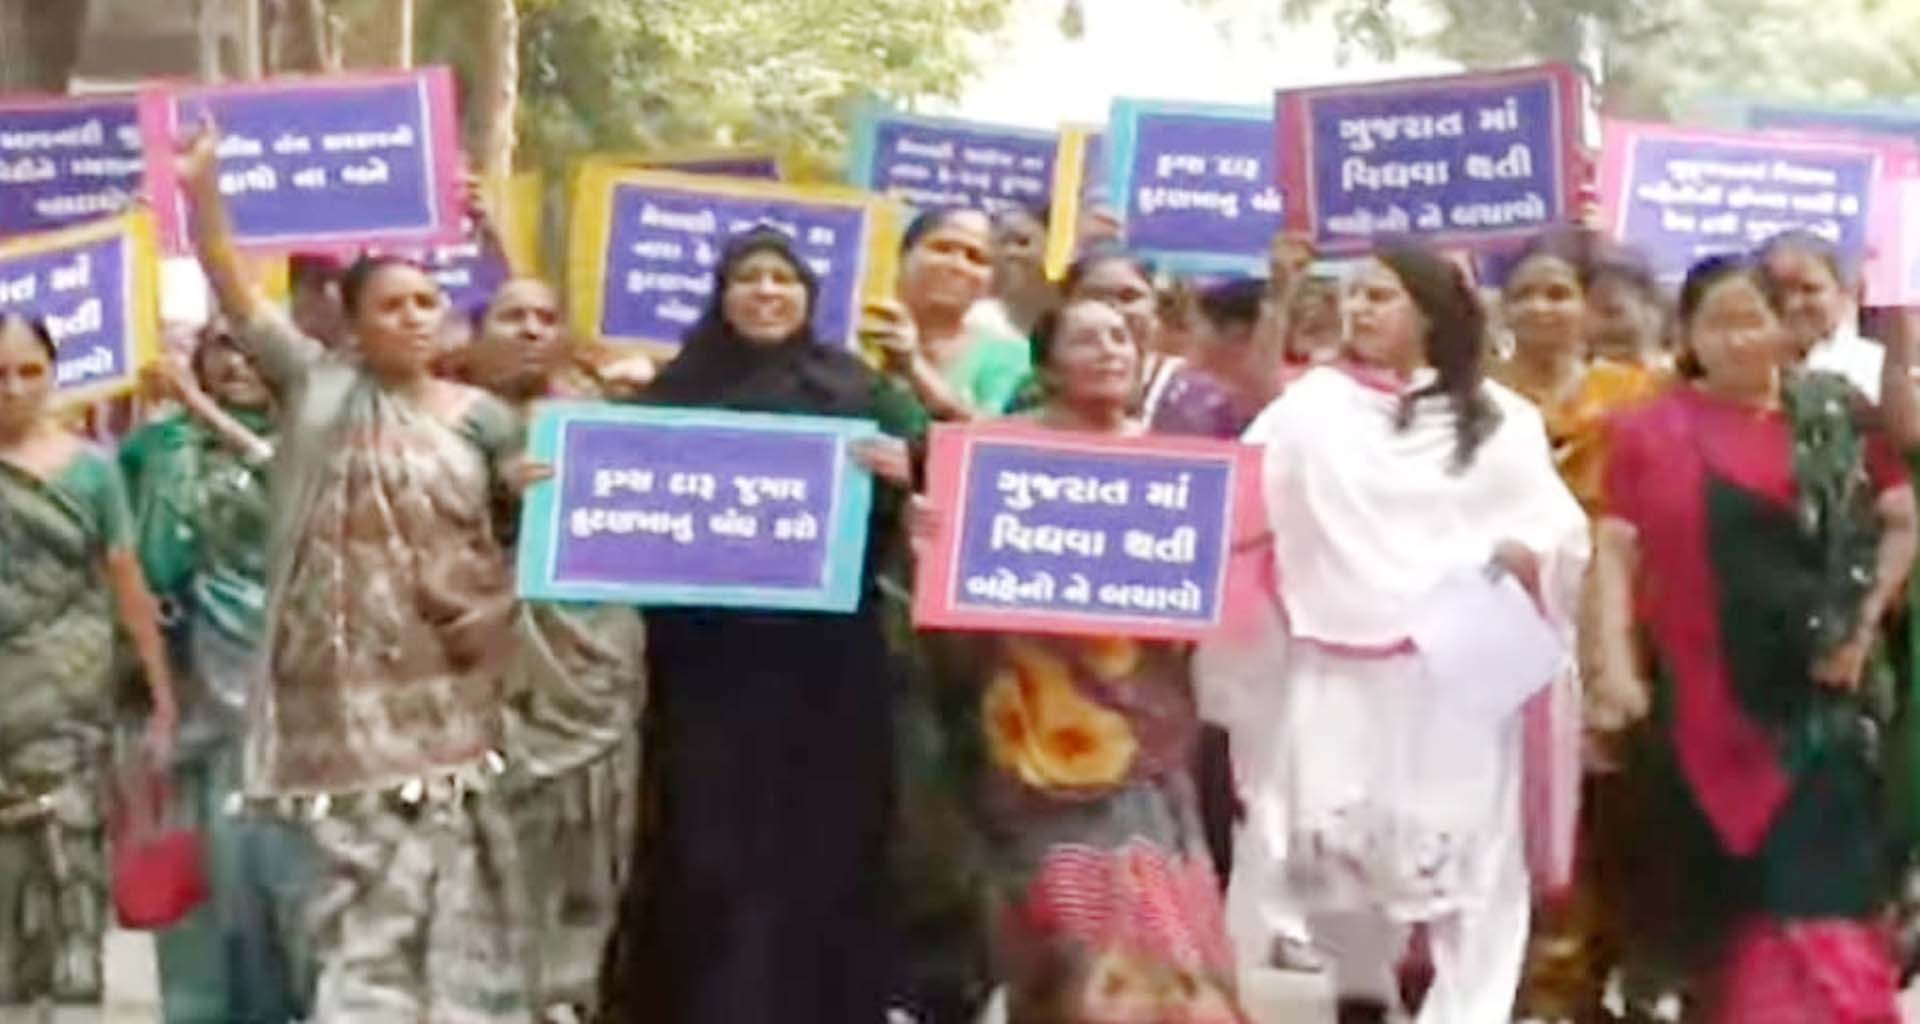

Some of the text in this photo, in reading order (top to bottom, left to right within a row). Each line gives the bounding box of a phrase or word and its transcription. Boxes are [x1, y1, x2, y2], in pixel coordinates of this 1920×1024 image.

[1340, 97, 1518, 151] ગુજરાત માં
[1341, 143, 1532, 191] વિધવા થતી
[1451, 193, 1546, 225] બચાવો
[733, 475, 807, 506] જુગાર
[996, 470, 1190, 509] ગુજરાત માં
[774, 511, 817, 540] કરો
[990, 513, 1196, 562] વિધવા થતી
[966, 567, 1201, 610] બહેનો ને બચાવો
